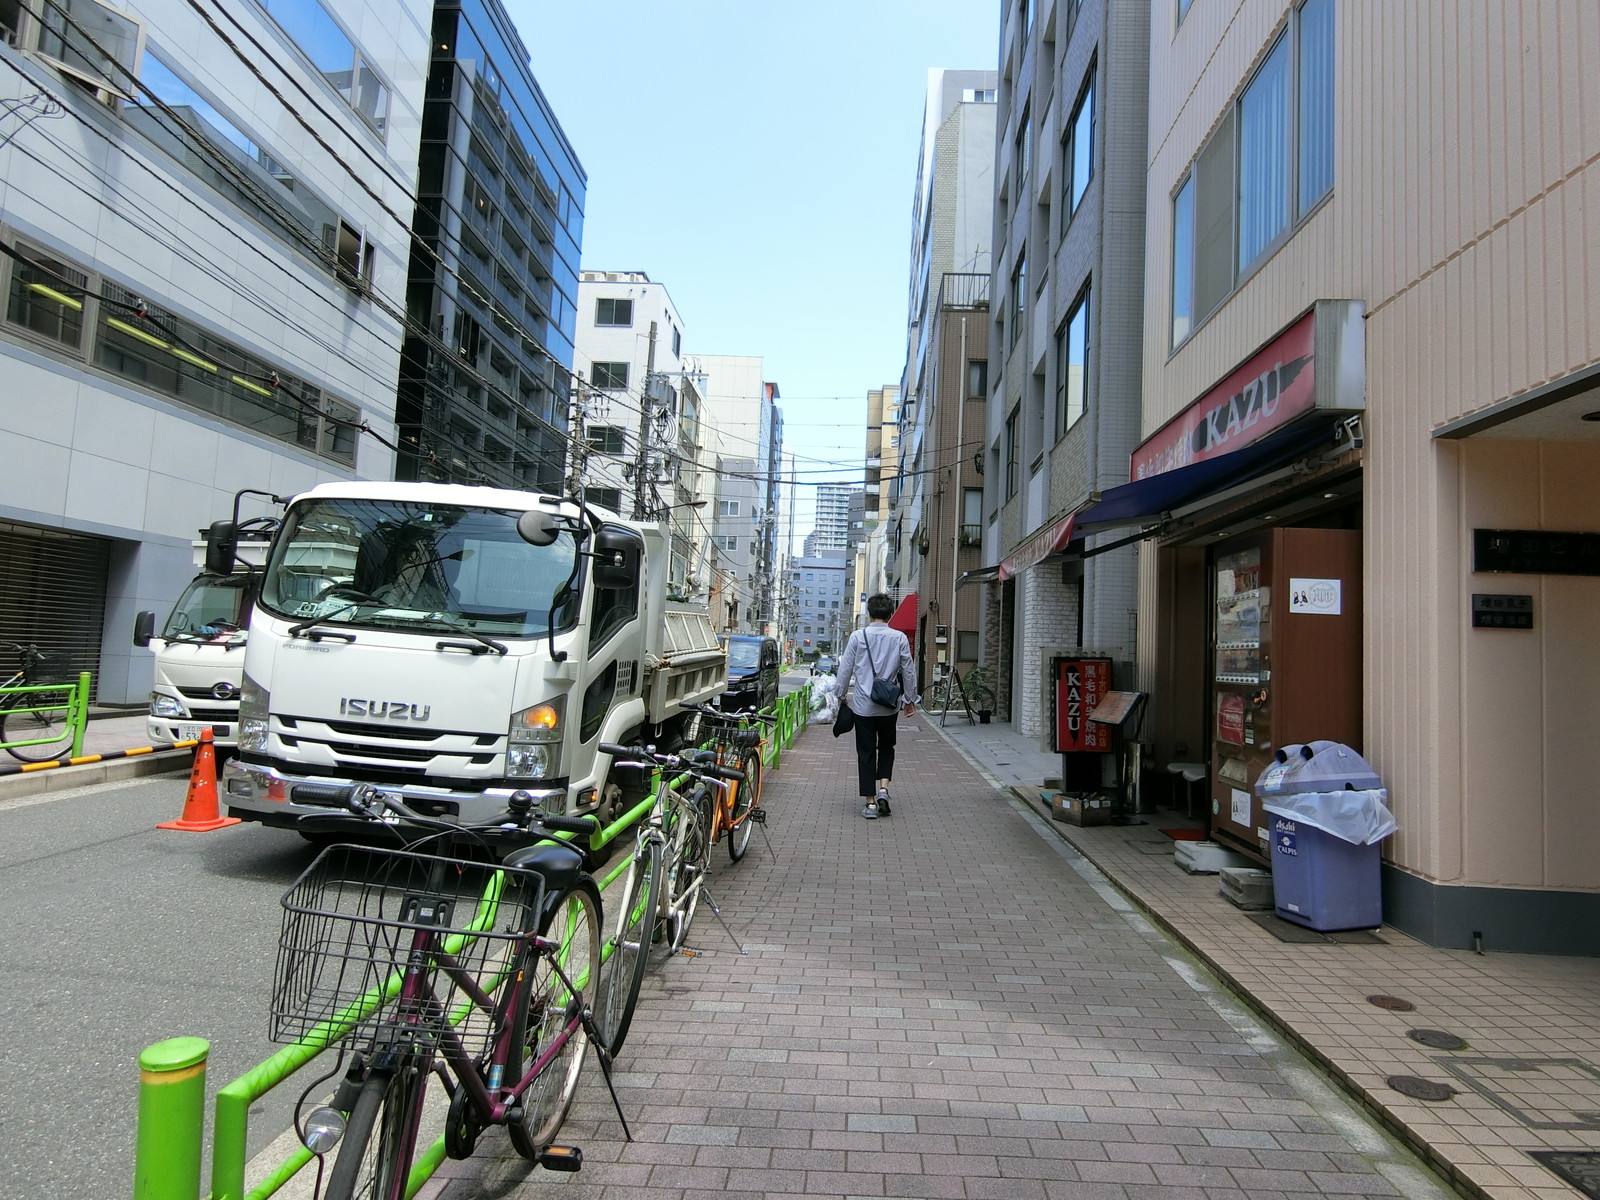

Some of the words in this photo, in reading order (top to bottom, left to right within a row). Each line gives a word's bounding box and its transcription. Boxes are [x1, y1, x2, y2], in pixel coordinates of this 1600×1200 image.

[1204, 362, 1282, 453] KAZU
[282, 643, 330, 653] FORWARD
[340, 697, 431, 722] ISUZU
[1067, 672, 1081, 731] KAZU
[1085, 665, 1096, 746] 黒毛和牛焼肉
[1276, 819, 1296, 832] Asahi
[1277, 845, 1298, 856] CALPIS
